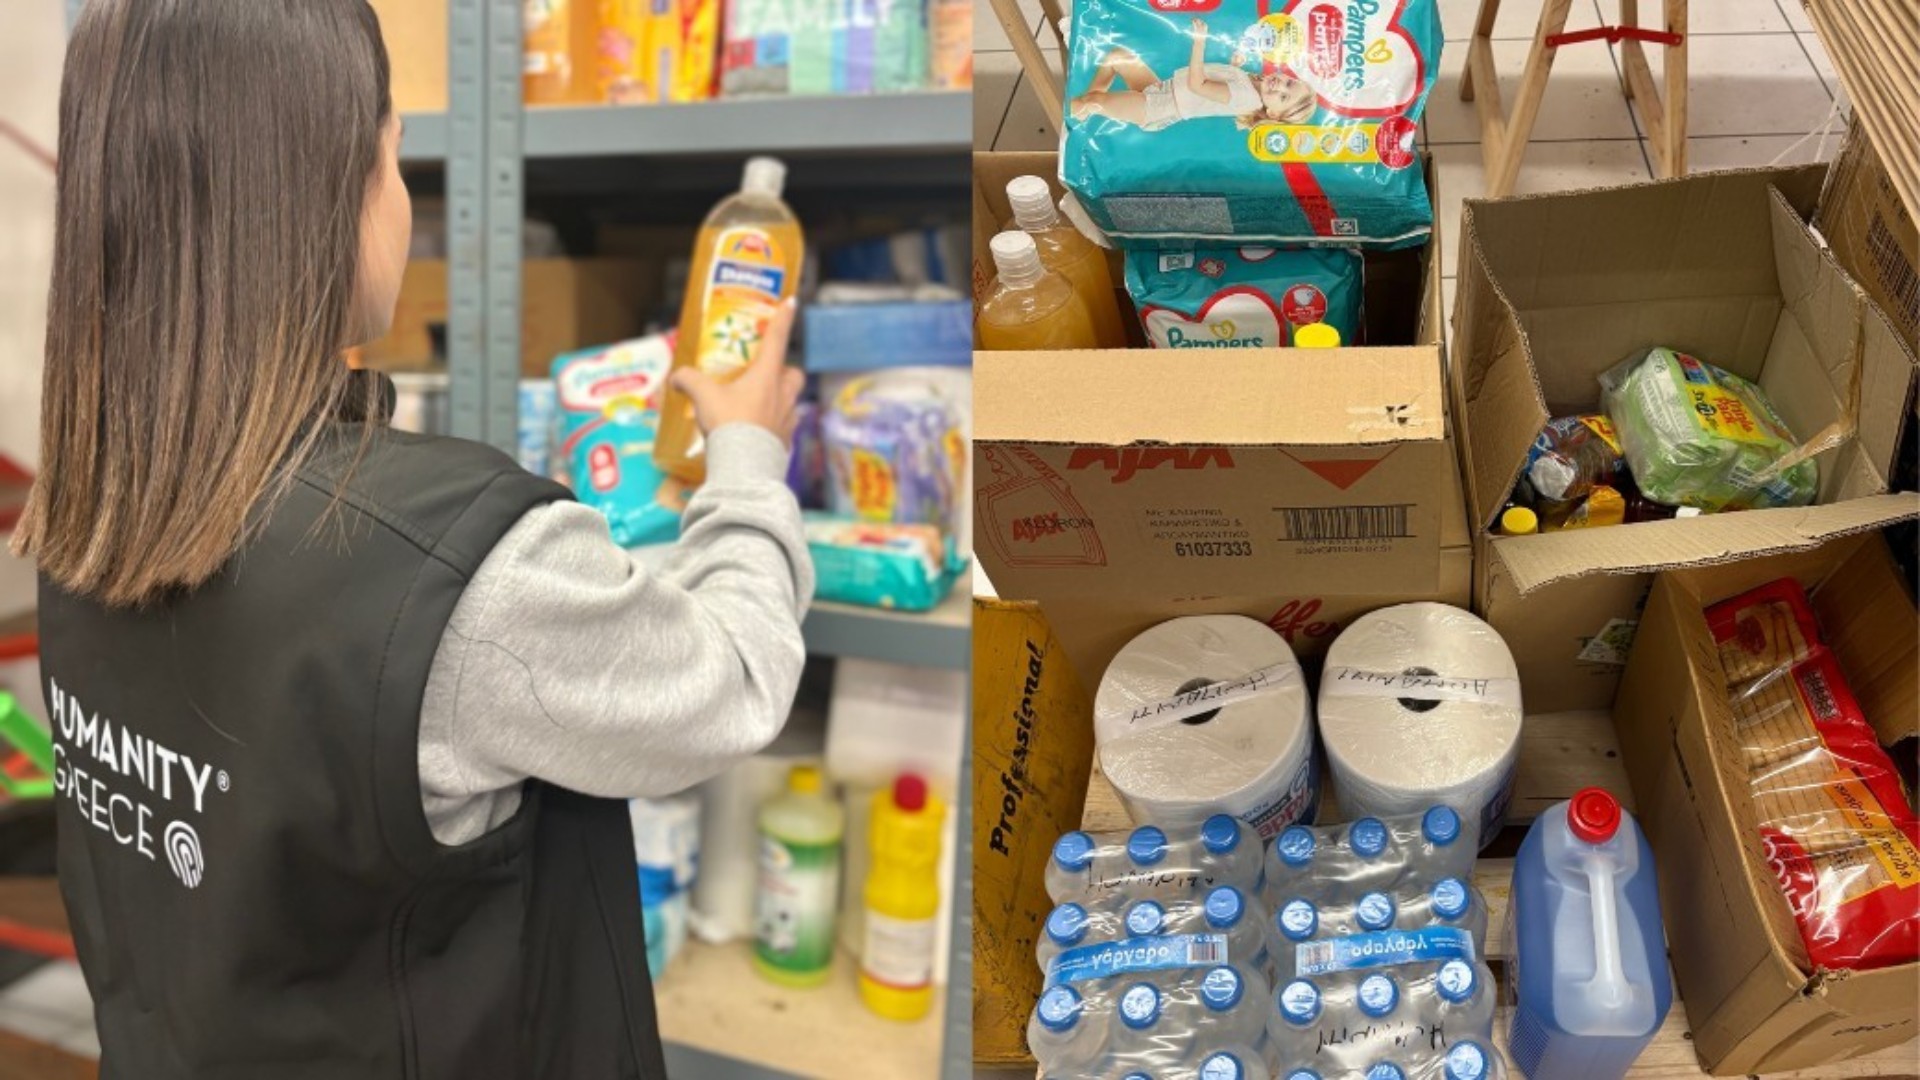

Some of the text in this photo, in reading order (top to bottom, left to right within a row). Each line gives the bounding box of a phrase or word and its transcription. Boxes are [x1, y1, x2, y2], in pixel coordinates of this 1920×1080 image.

[1343, 0, 1380, 91] Pampers
[1166, 326, 1264, 348] Pampers
[1174, 541, 1253, 557] 61037333
[990, 639, 1045, 857] Professional
[1351, 933, 1428, 957] γάργαρο
[1091, 945, 1169, 970] γάργαρο
